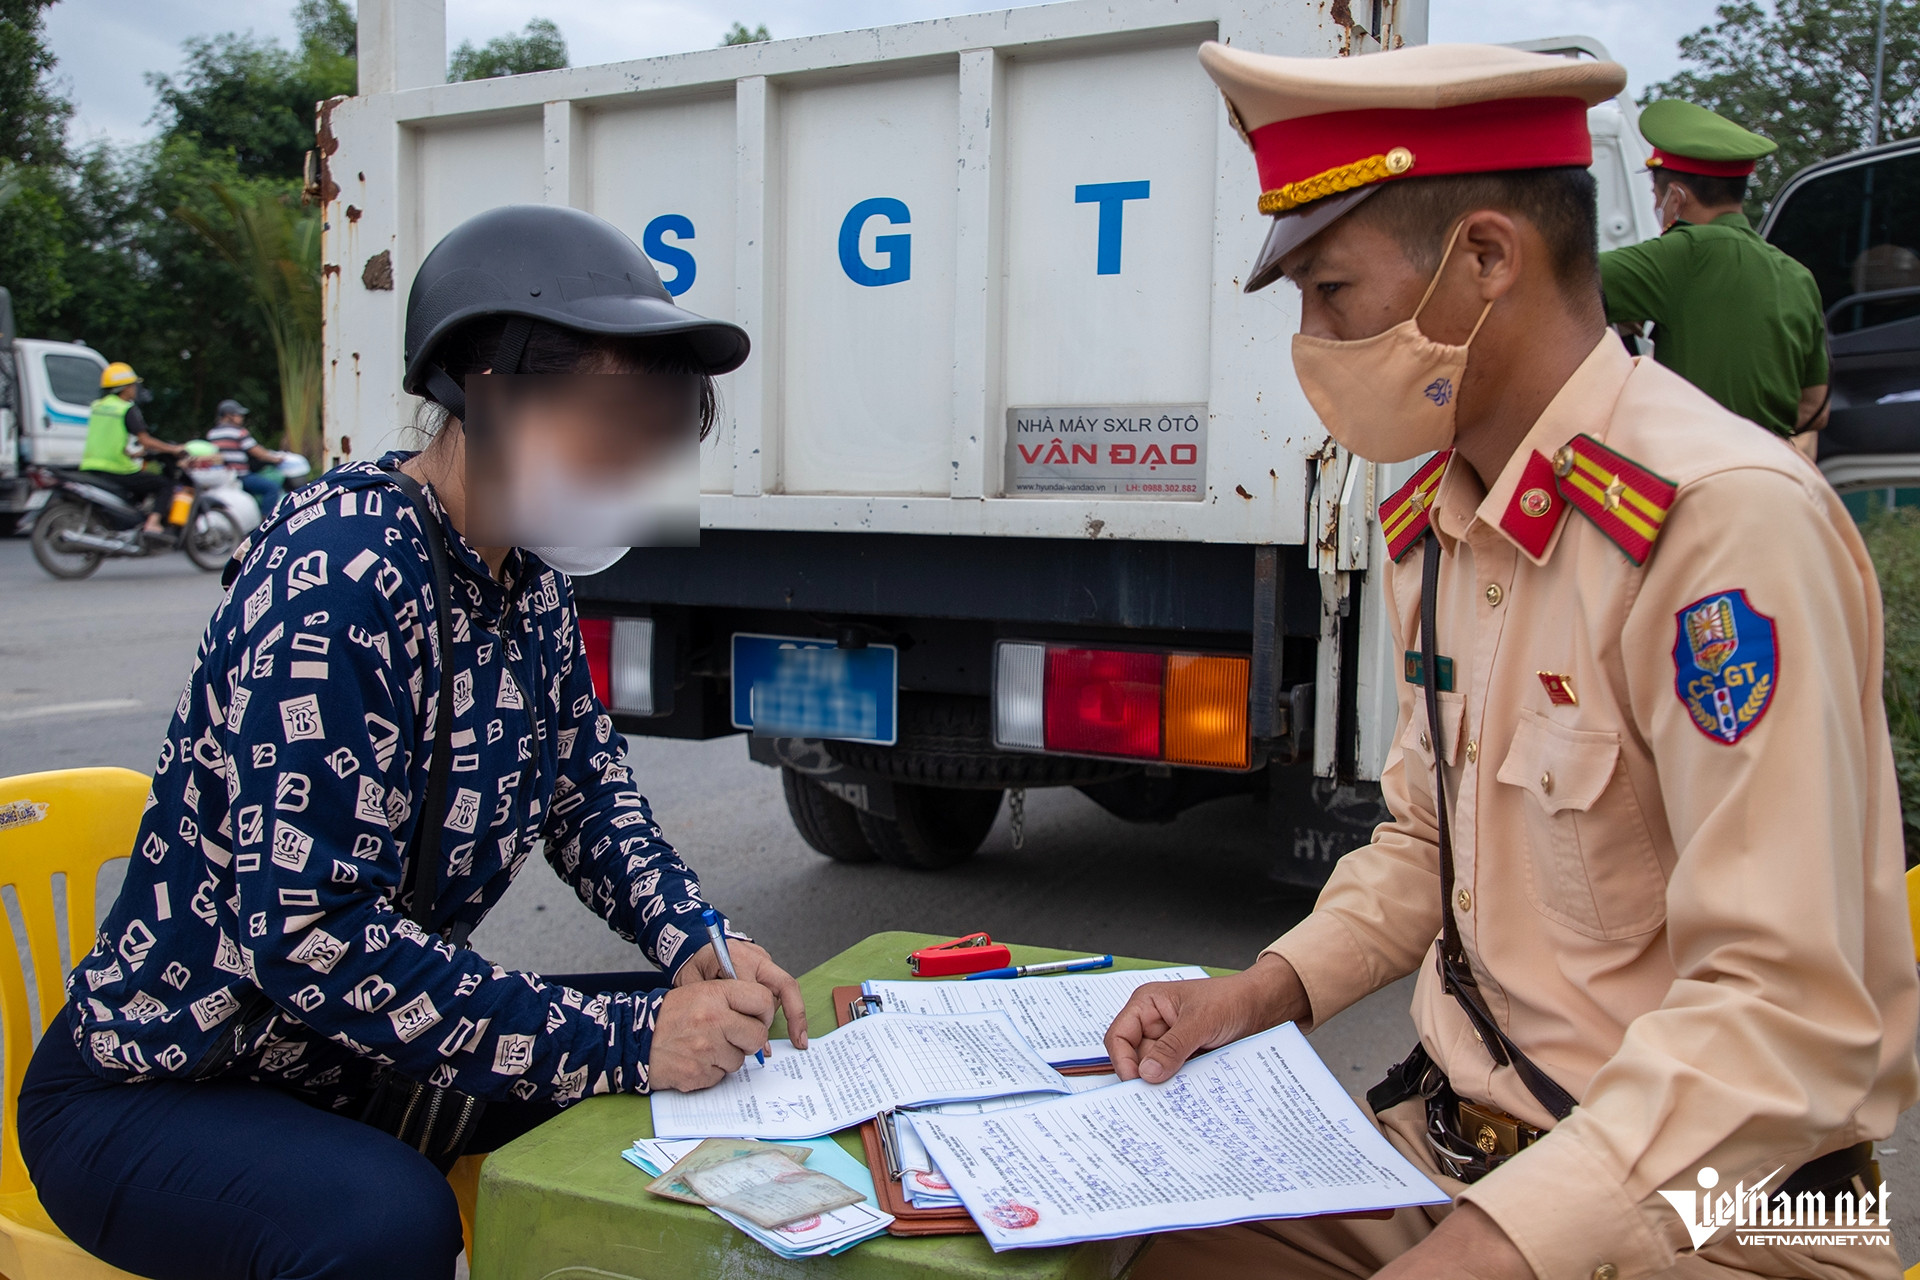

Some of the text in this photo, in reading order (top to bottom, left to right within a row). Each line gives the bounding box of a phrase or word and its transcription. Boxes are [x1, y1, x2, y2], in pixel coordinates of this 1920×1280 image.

[643, 180, 1150, 299] S G T
[1017, 414, 1199, 432] NHÀ MÁY SXLR ÔTÔ
[1017, 437, 1198, 471] VÂN ĐẠO
[1016, 483, 1197, 493] www.hyundai-vandao.vn LH: 0988.302.882
[1724, 662, 1757, 687] GT
